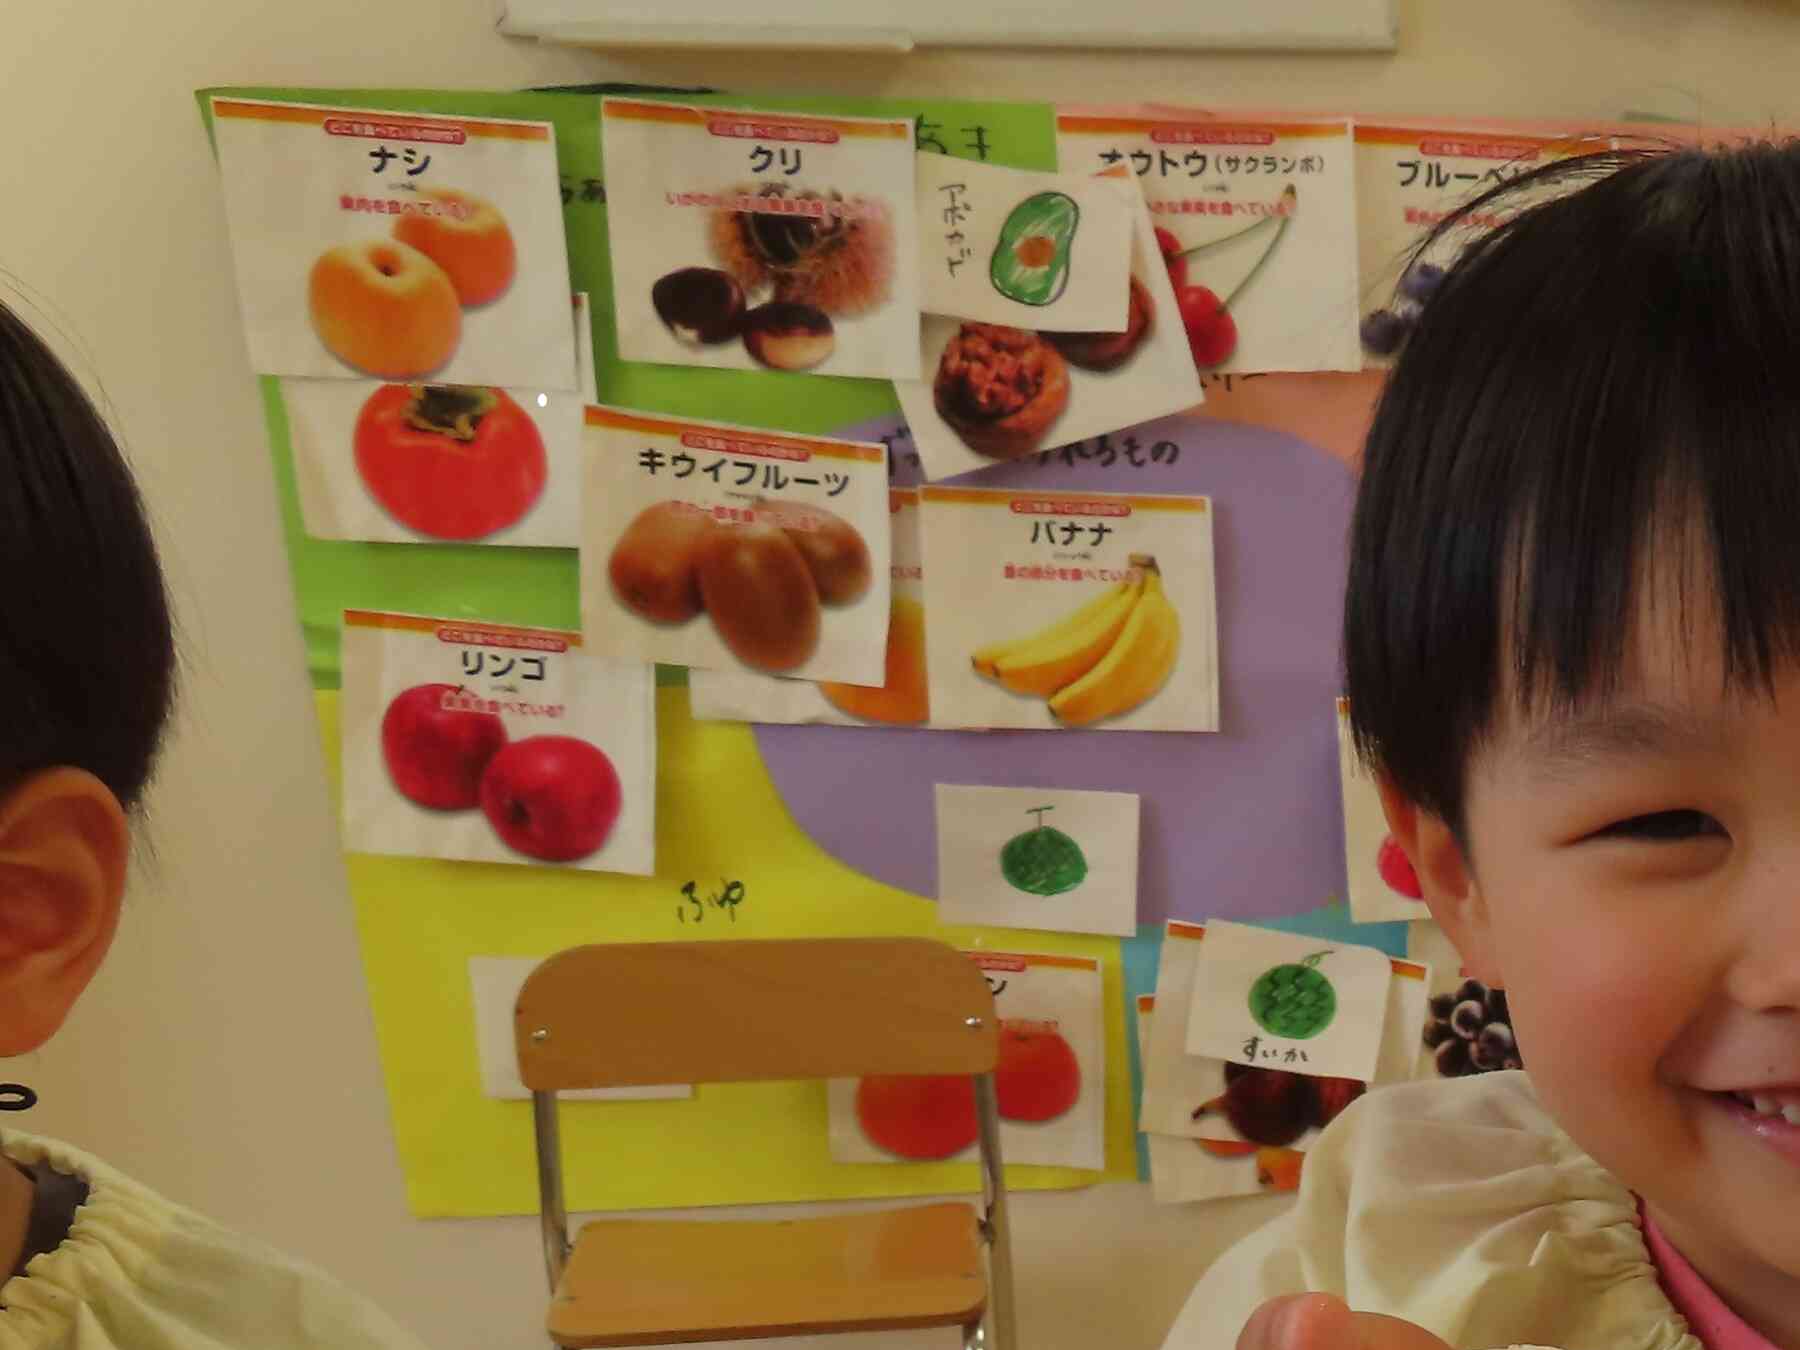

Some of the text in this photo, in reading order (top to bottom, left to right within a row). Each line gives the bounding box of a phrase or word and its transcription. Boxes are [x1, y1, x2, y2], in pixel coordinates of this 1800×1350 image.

[369, 145, 431, 176] ナシ
[749, 145, 801, 175] クリ
[639, 448, 849, 497] キウイフルーツ
[1031, 519, 1113, 546] バナナ
[462, 650, 547, 681] リンゴ
[1240, 1036, 1309, 1063] すいか
